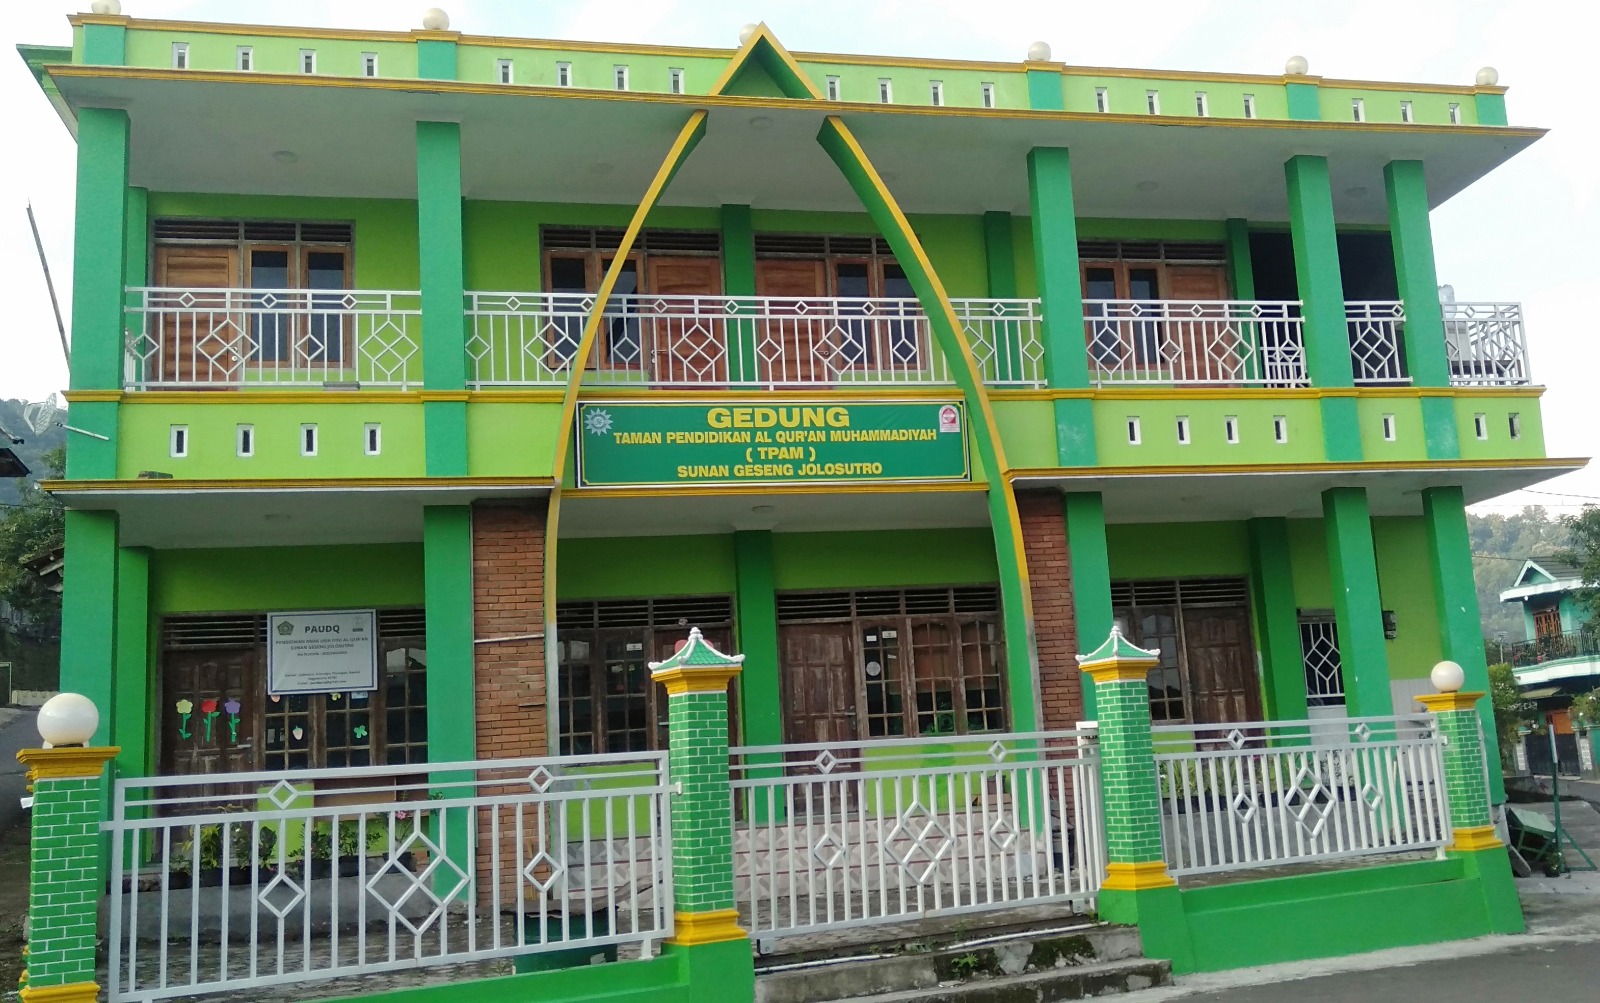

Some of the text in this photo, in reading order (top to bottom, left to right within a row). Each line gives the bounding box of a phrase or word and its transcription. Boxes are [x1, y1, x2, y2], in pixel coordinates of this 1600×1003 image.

[707, 407, 849, 429] GEDUNG
[613, 429, 937, 444] TAMAN PENDIDIKAN AL QUR'AN MUHAMMADIYAH
[757, 447, 804, 460] TPAM
[677, 462, 883, 478] SUNAN GESENG JOLOSUTRO
[304, 625, 340, 633] PAUDQ
